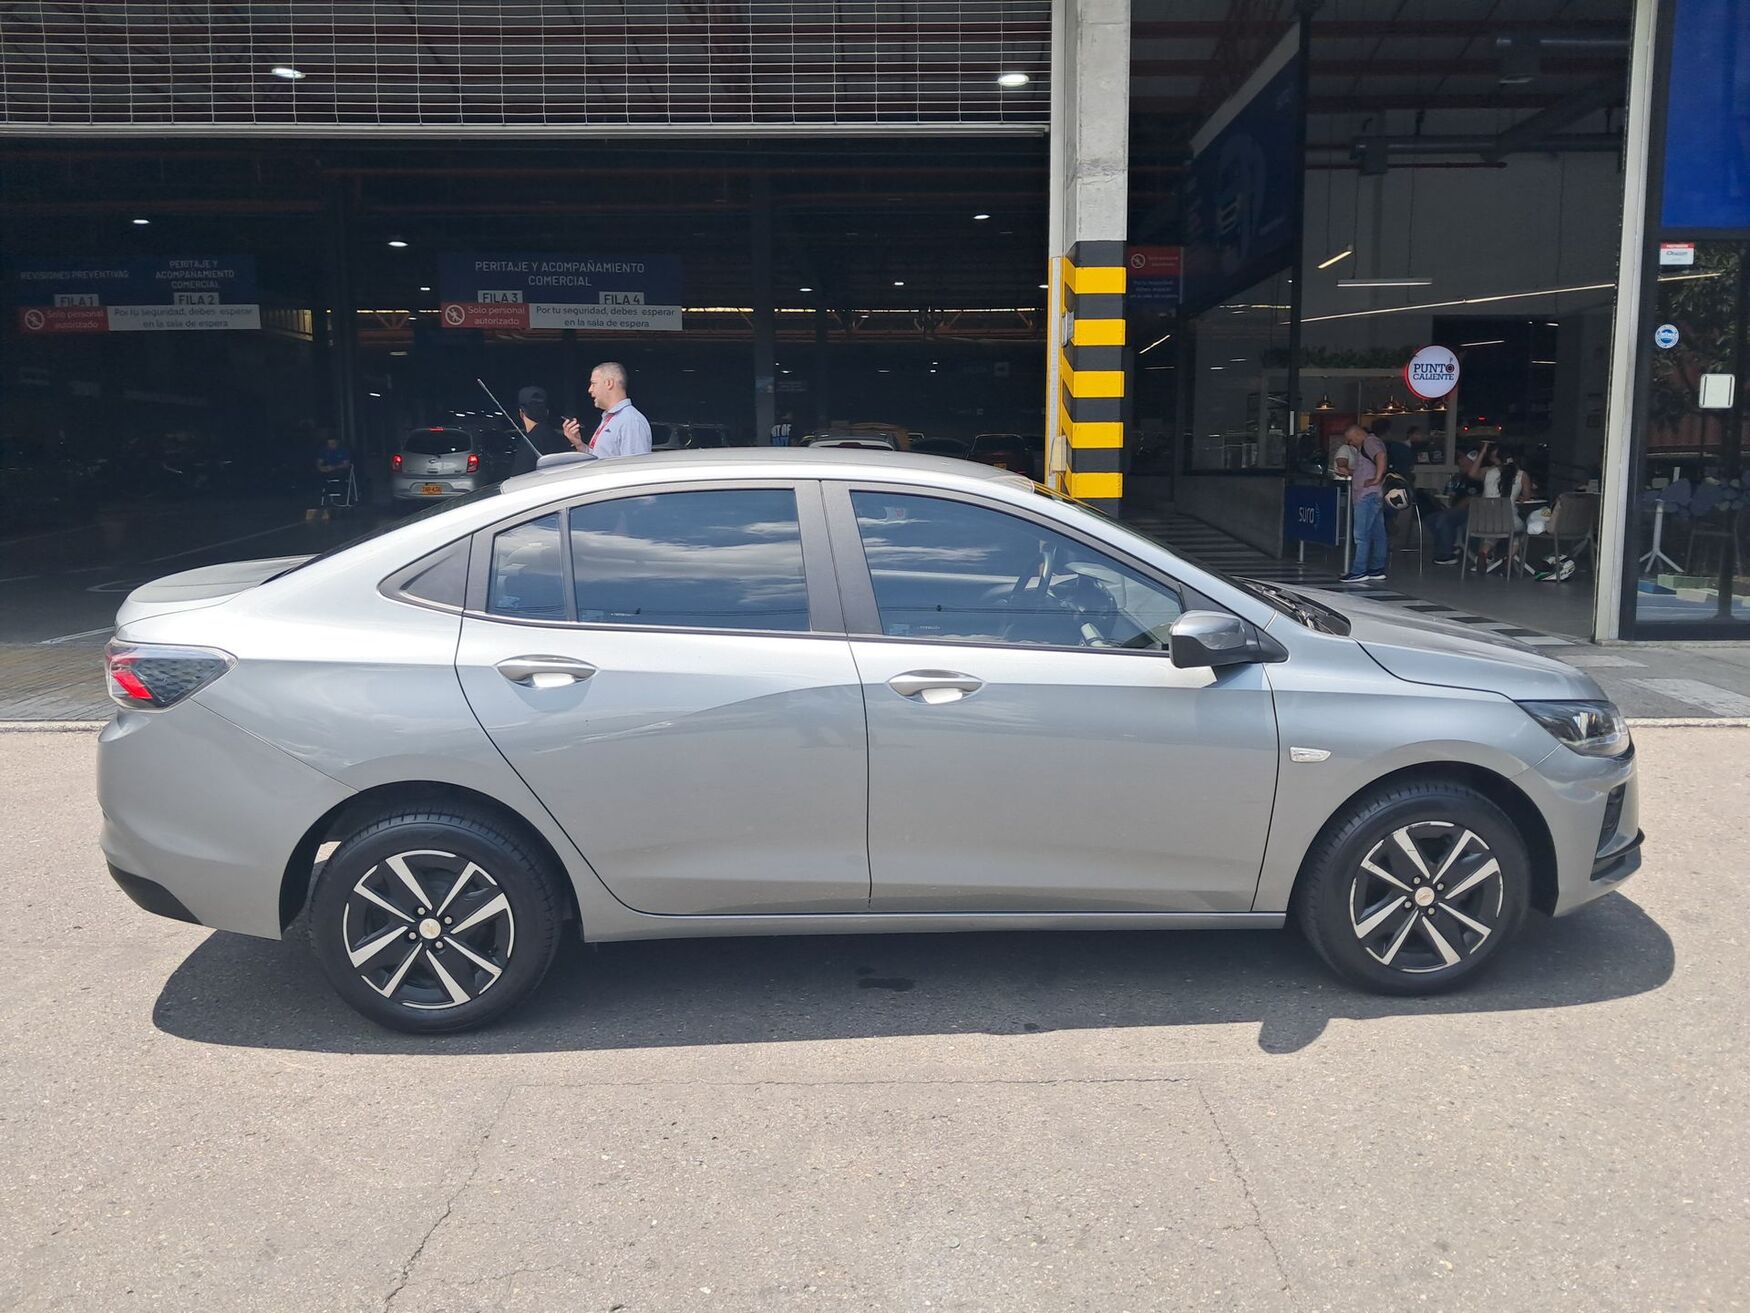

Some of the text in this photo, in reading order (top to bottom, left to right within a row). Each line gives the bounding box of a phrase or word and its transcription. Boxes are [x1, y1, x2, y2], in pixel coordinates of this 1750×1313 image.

[475, 260, 645, 273] PERITAJE Y ACOMPAÑAMIENTO
[171, 280, 220, 289] COMERCIAL
[528, 275, 592, 286] COMERCIAL
[60, 296, 85, 306] FILA
[178, 295, 215, 305] FILA 2
[482, 293, 518, 303] FILA 3
[604, 294, 640, 305] FILA 4
[468, 306, 525, 317] Solo personal
[536, 306, 550, 315] Por
[552, 307, 561, 315] tu
[611, 308, 638, 317] debes
[641, 309, 675, 319] esperar
[474, 318, 519, 326] autorizado
[577, 318, 585, 327] la
[587, 319, 605, 327] sala
[606, 319, 617, 328] de
[619, 321, 650, 330] espera
[1413, 363, 1455, 373] PUNTO
[1413, 373, 1454, 381] CALIENTE
